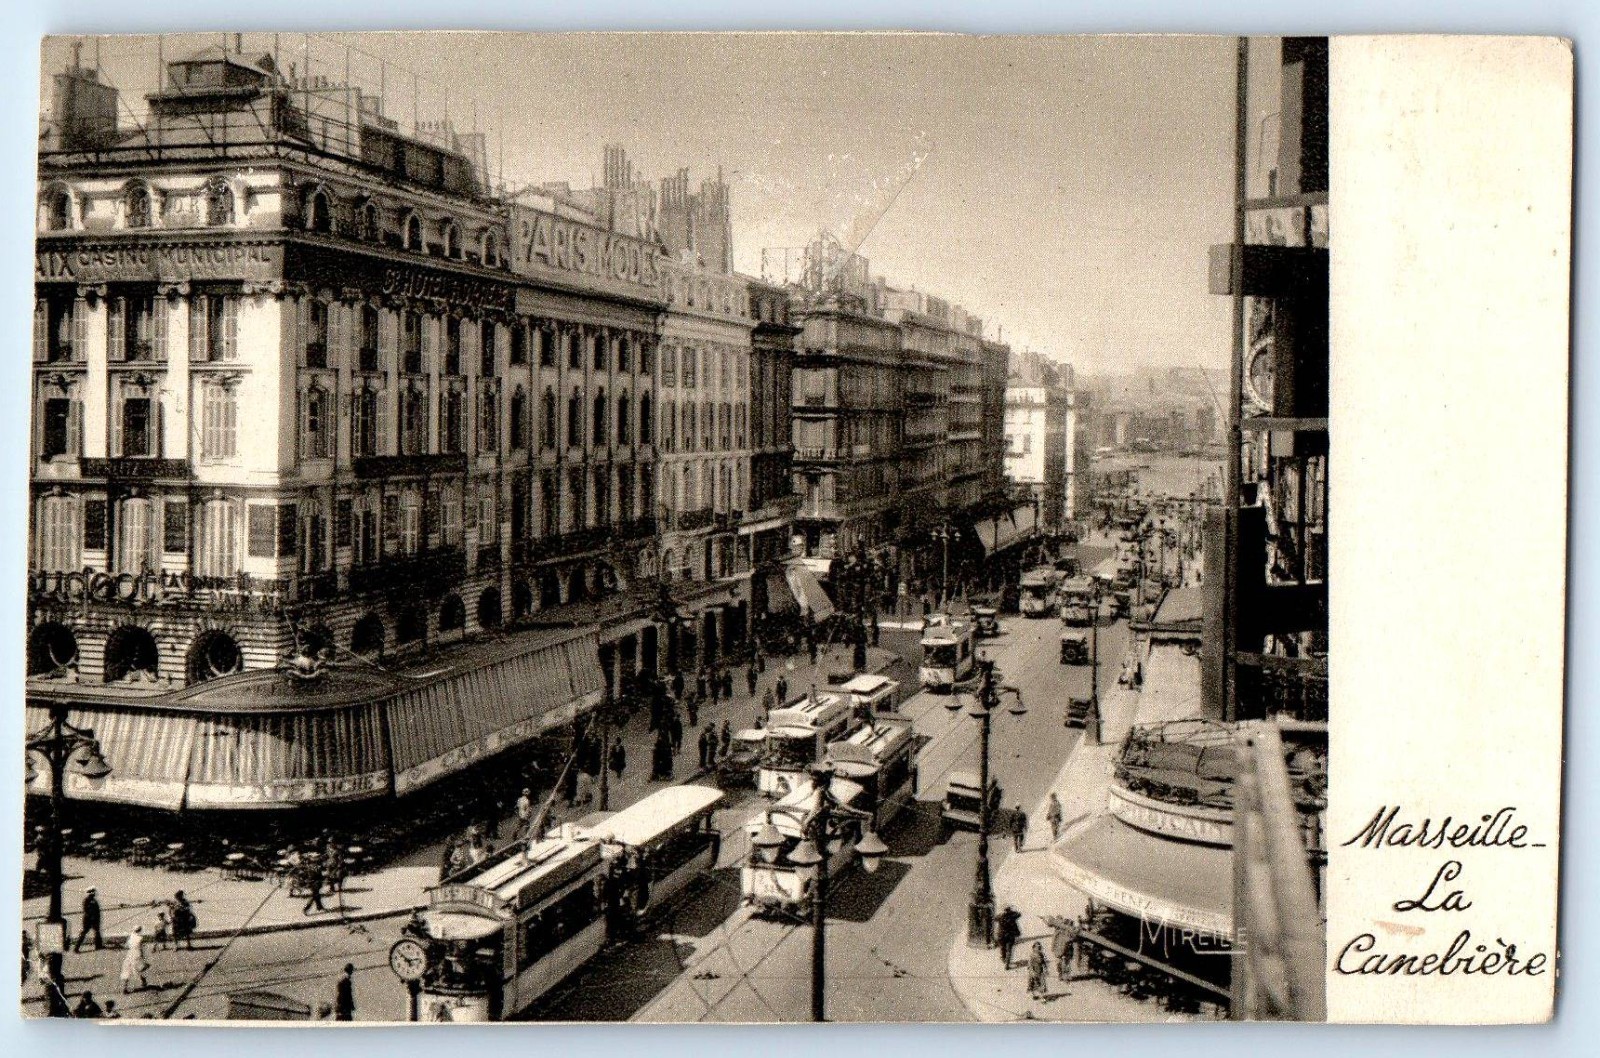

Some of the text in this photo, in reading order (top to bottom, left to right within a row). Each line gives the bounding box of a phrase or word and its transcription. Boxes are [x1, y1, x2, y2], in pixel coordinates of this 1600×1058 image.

[517, 214, 588, 274] PARIS
[77, 250, 149, 267] CASINO
[159, 246, 271, 267] MUNICIPAL
[314, 775, 374, 799] RICHE
